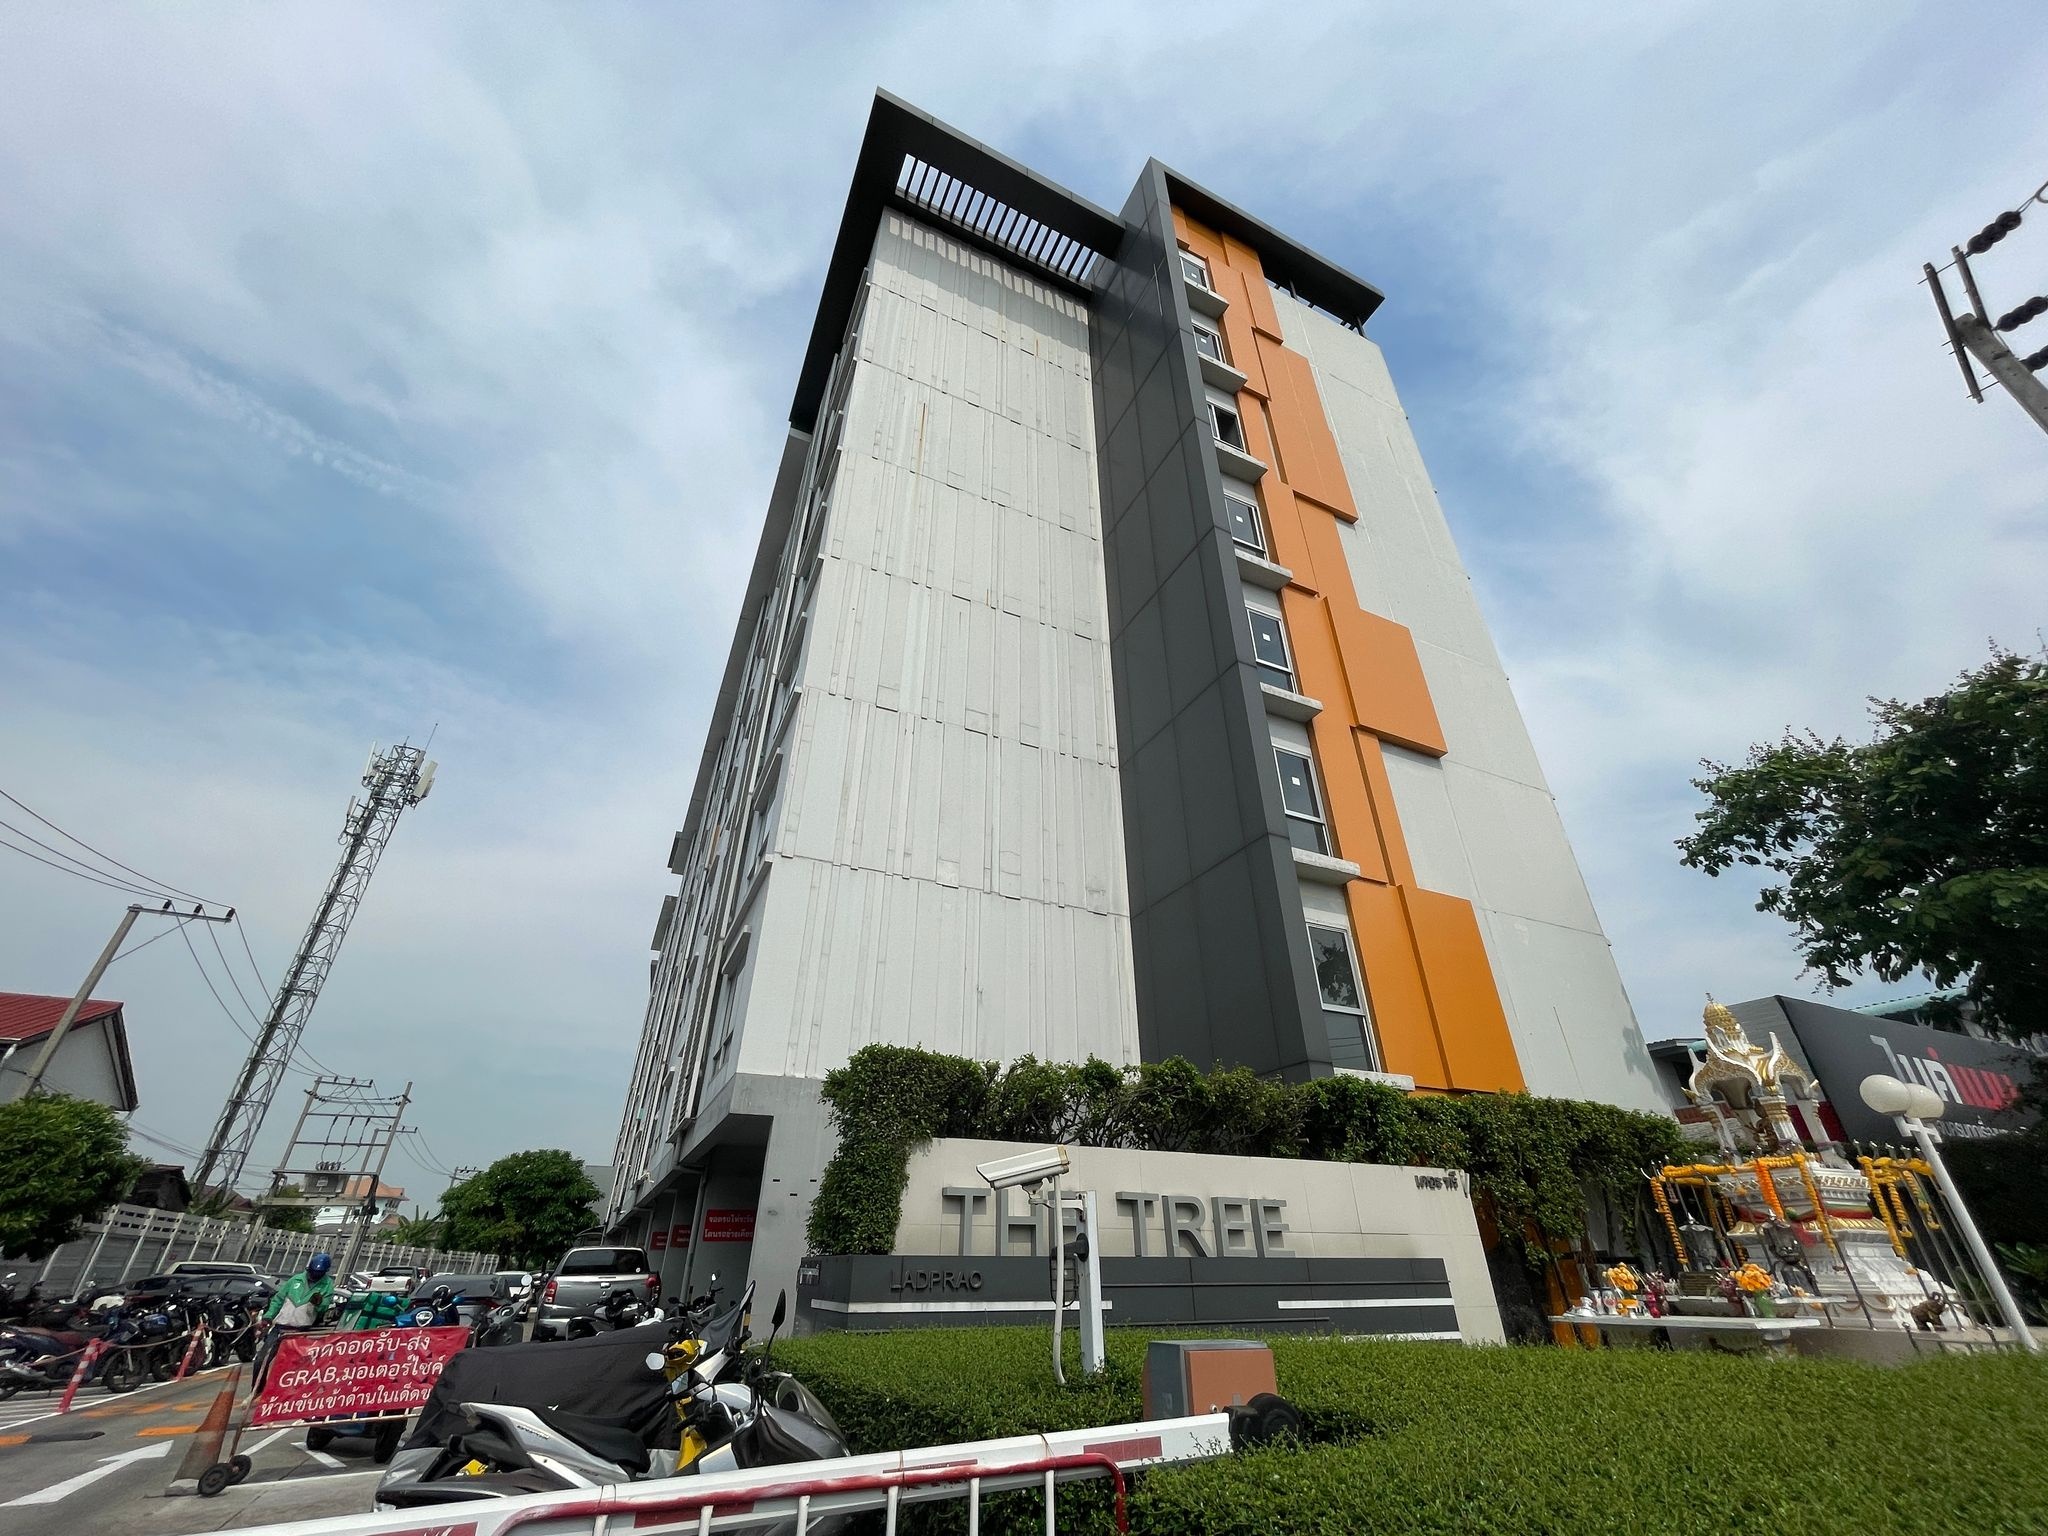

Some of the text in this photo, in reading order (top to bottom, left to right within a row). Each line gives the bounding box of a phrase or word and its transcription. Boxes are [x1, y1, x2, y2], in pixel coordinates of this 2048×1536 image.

[1116, 1191, 1296, 1258] TREE
[889, 1269, 983, 1293] LADPRAO
[307, 1330, 431, 1366] จุดจอดรับ-ส่ง
[260, 1384, 431, 1417] ห้ามขับเข้าด้านในเด็ดข
